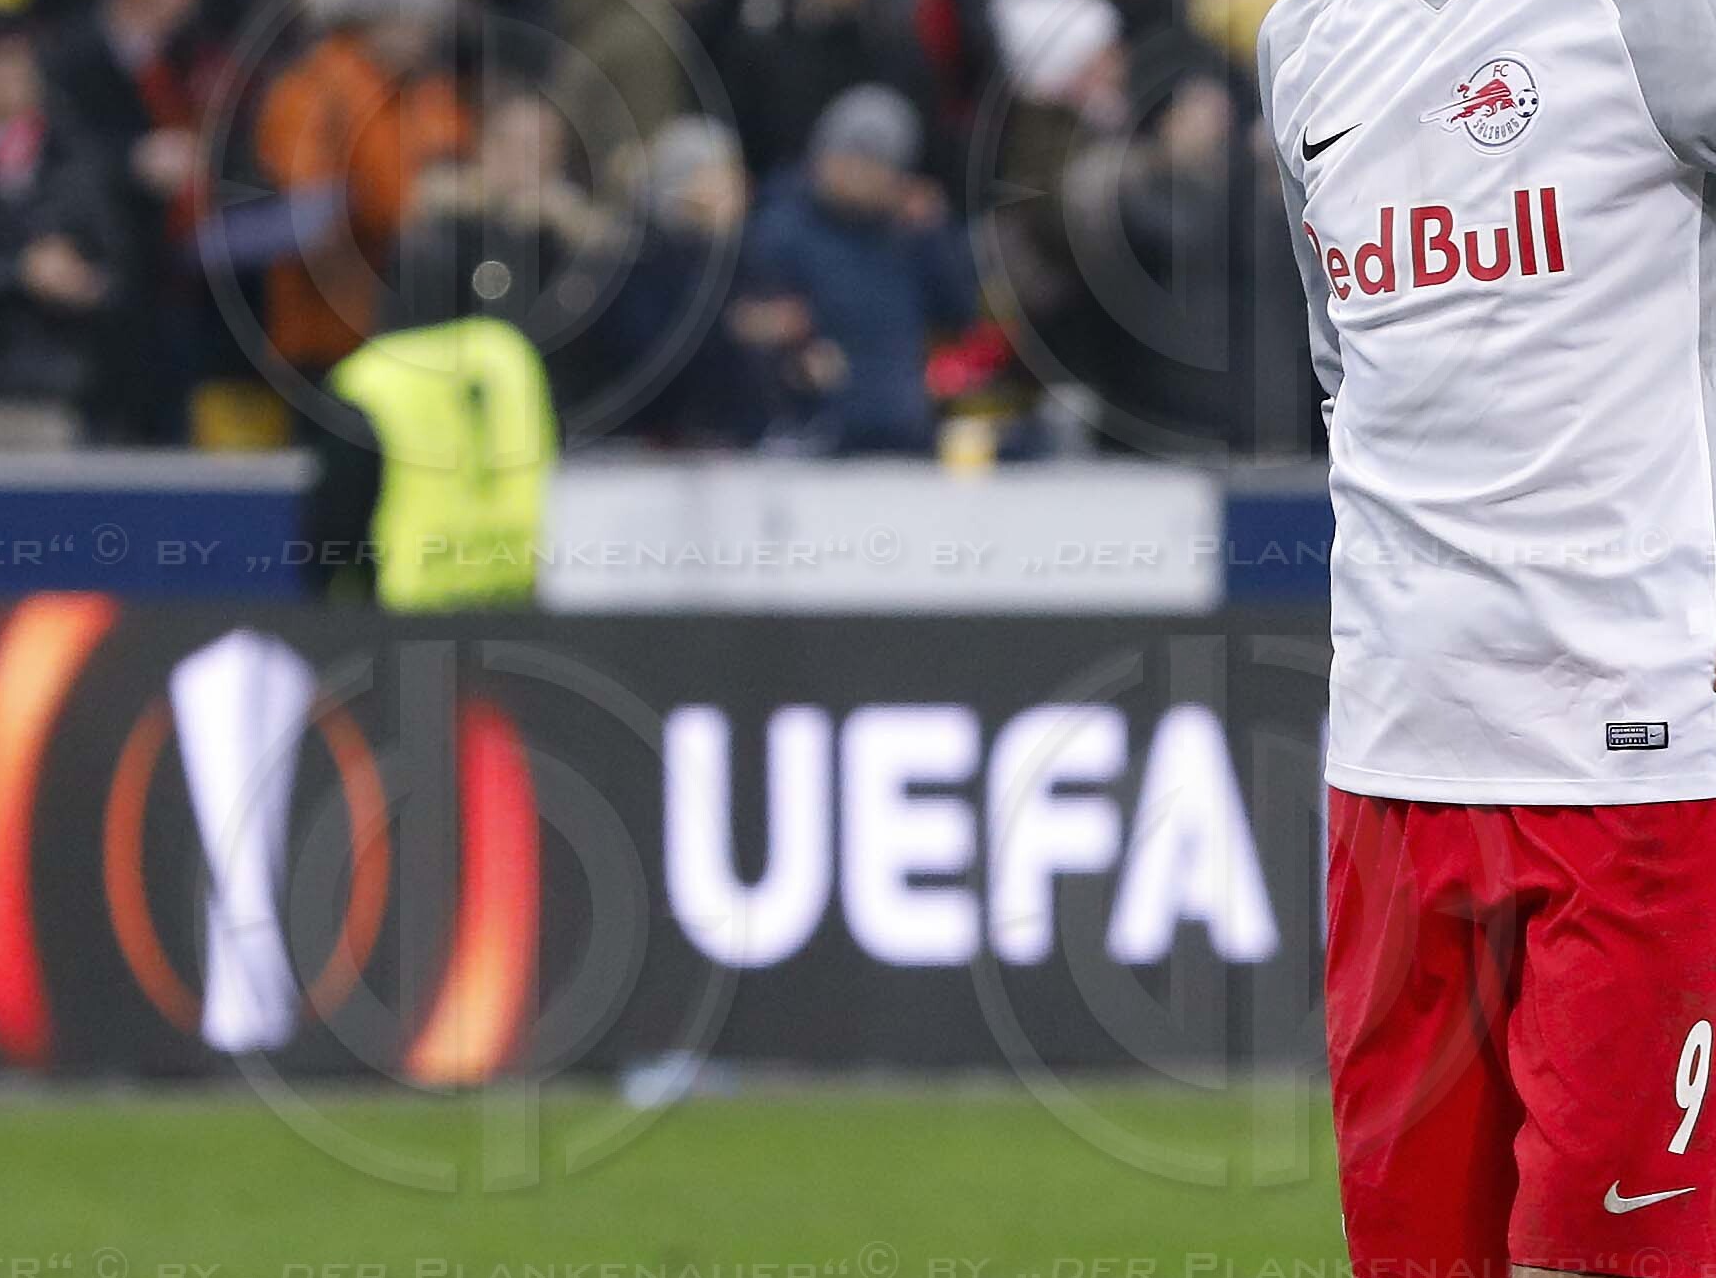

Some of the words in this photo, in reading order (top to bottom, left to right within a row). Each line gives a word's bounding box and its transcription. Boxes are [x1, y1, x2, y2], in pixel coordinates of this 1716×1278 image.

[1493, 64, 1509, 77] FC
[1410, 186, 1565, 288] Bull
[662, 702, 1282, 968] UEFA
[1667, 1019, 1713, 1155] 9
